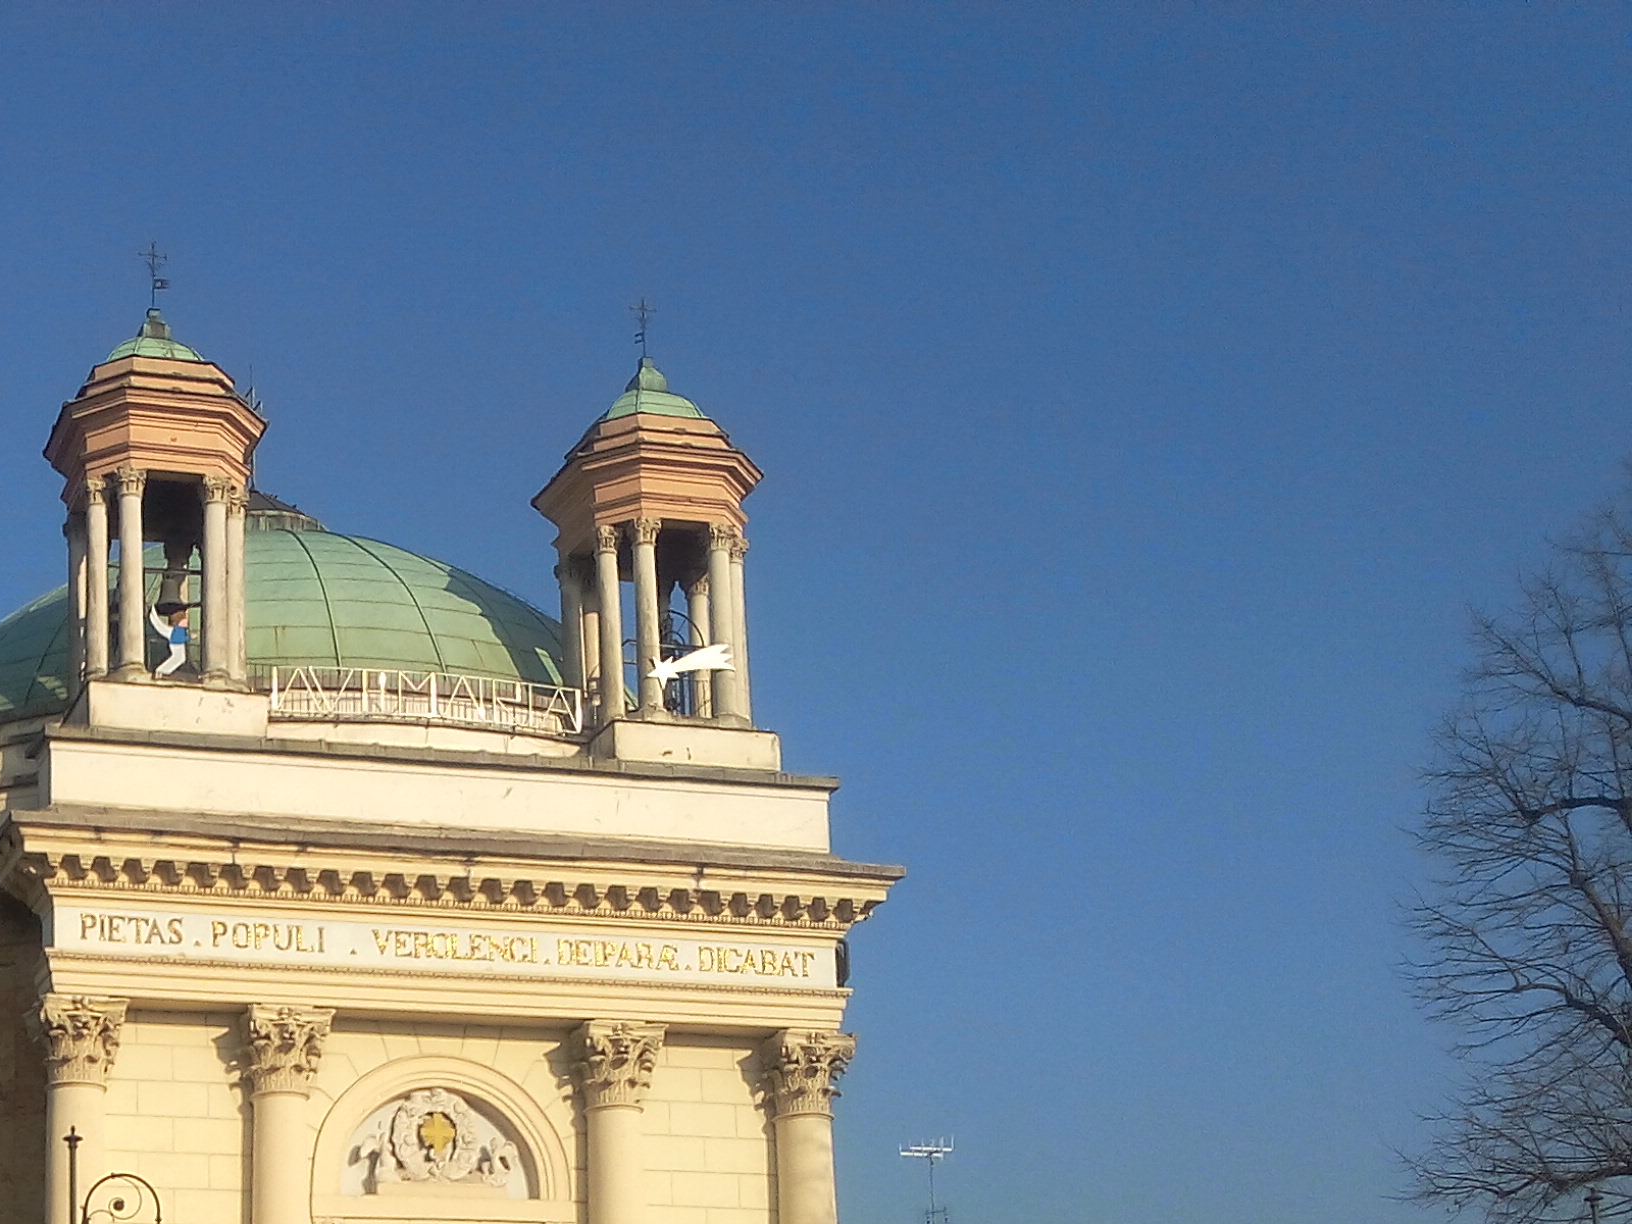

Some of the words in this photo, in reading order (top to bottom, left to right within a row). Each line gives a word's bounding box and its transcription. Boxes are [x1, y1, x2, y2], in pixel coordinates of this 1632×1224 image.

[398, 670, 582, 733] MARIA
[79, 913, 184, 945] PIETAS
[210, 920, 326, 953] POPULI
[698, 945, 815, 977] DICABAT
